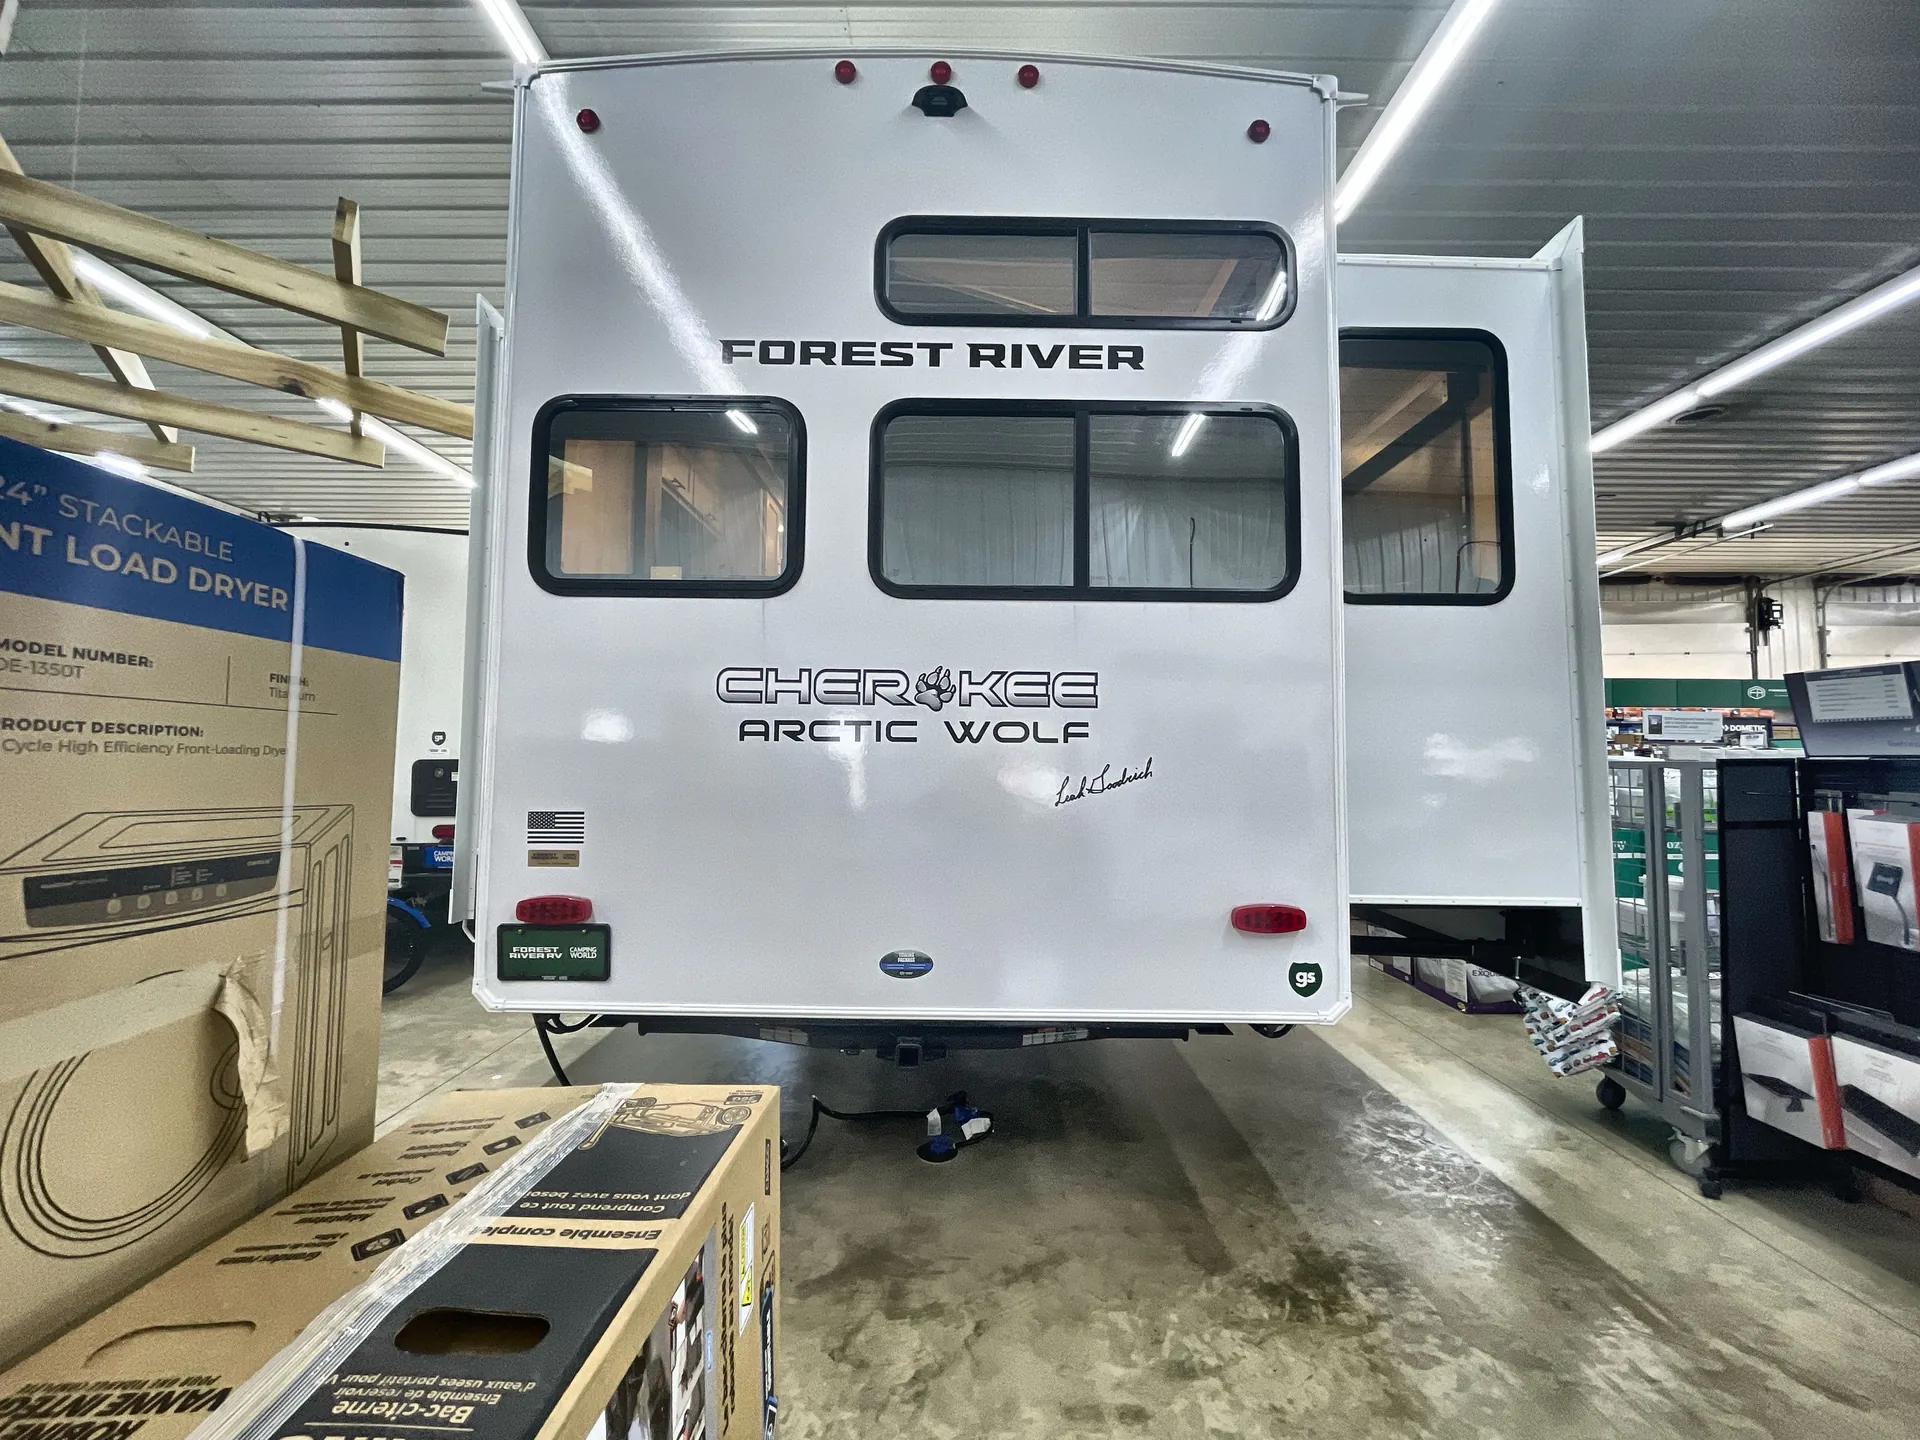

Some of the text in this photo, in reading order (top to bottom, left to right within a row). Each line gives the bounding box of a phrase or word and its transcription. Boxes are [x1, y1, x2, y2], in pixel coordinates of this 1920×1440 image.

[719, 339, 1145, 371] FOREST RIVER
[59, 493, 234, 562] STACKABLE
[66, 534, 178, 585] LOAD
[188, 566, 289, 612] DRYER
[72, 646, 154, 668] NUMBER:
[269, 672, 310, 687] FINH:
[269, 687, 316, 702] Titaum
[0, 717, 204, 738] RODUCT DESCRIPTION:
[739, 719, 1089, 744] ARCTIC WOLF
[1730, 724, 1767, 732] DOMETIC
[2, 738, 287, 758] Cycle High Efficiency Front-Loading Drye
[1295, 970, 1316, 986] gs
[522, 1190, 692, 1201] dont vous avez besoi
[541, 1202, 576, 1211] tout
[579, 1203, 666, 1214] Comprend
[478, 1225, 662, 1242] Ensemble comple
[720, 1201, 728, 1250] plus
[342, 1373, 380, 1385] pour
[379, 1374, 438, 1387] portatif
[486, 1379, 537, 1393] d'eaux
[404, 1388, 425, 1400] de
[427, 1389, 502, 1405] Ensemble
[331, 1400, 475, 1424] Bac-citerne
